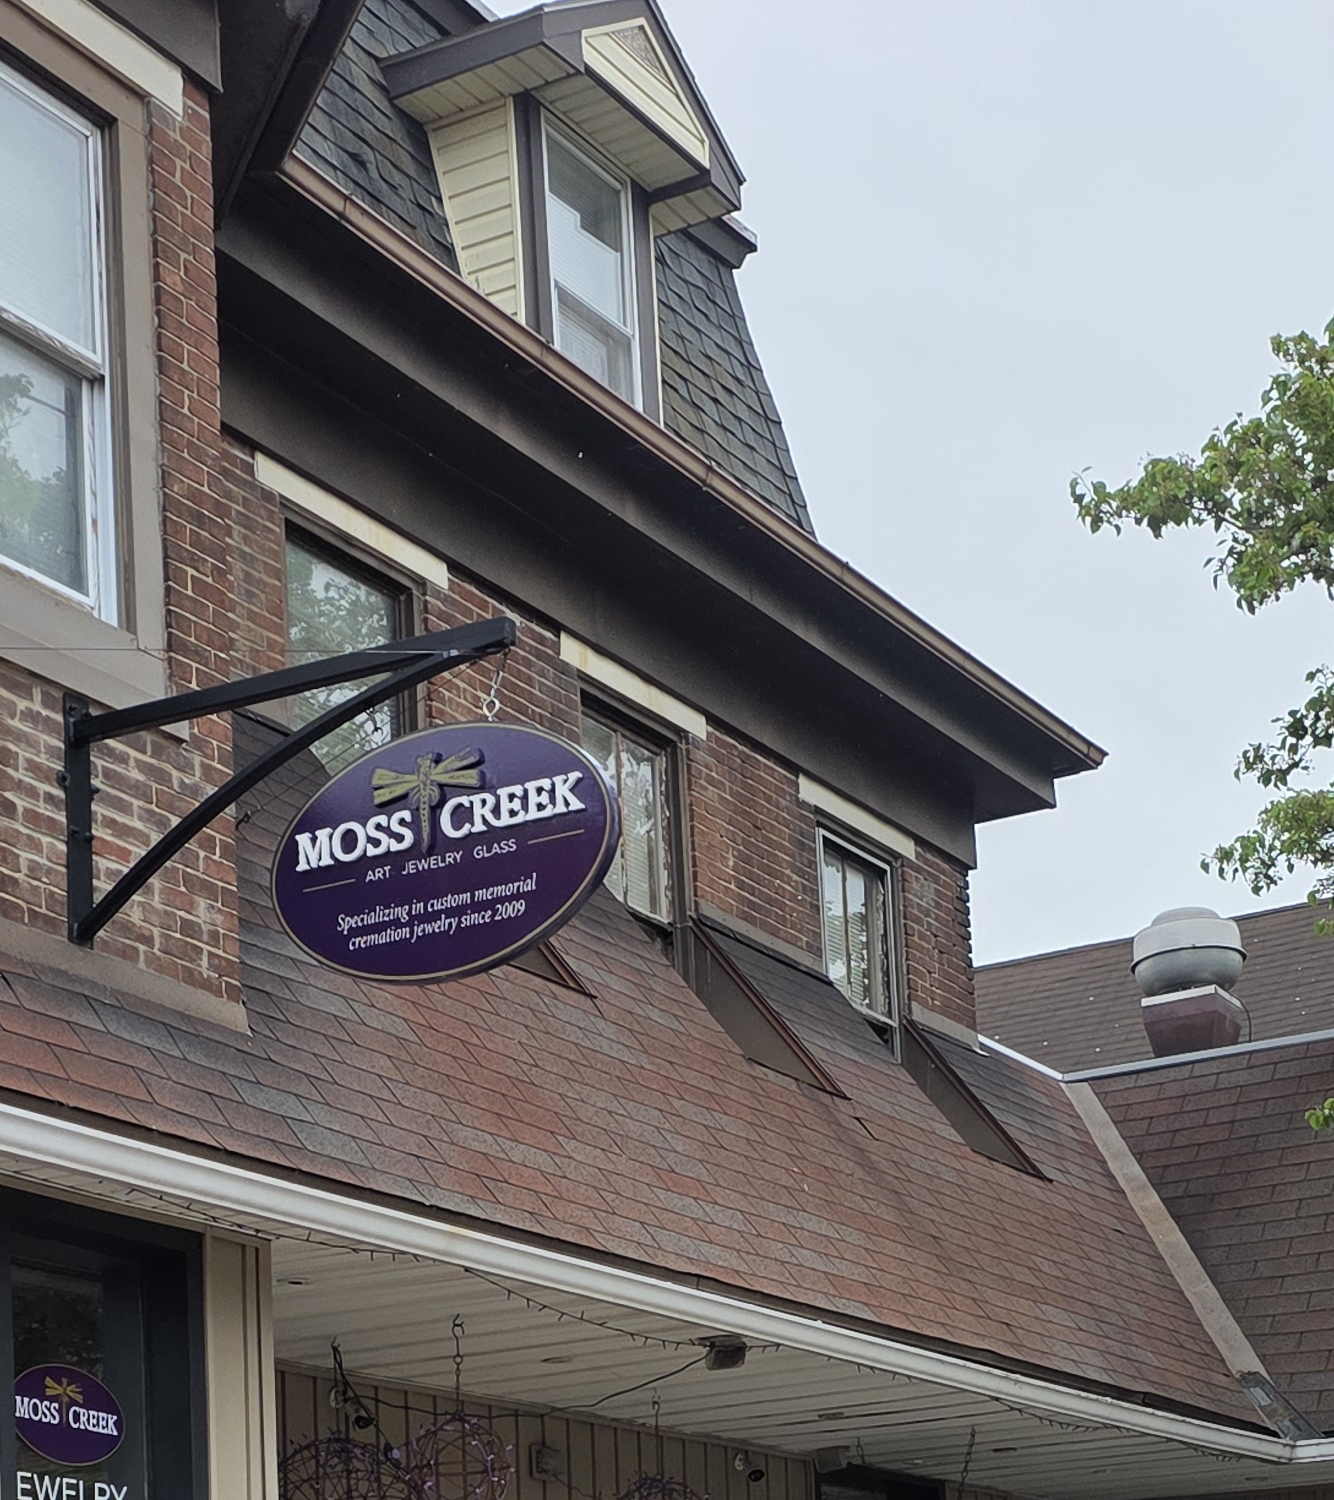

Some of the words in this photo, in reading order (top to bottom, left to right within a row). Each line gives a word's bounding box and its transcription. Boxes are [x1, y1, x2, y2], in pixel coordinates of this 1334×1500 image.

[295, 809, 414, 872] MOSS
[440, 771, 586, 839] CREEK
[365, 865, 392, 882] ART
[401, 851, 463, 876] JEWELRY
[473, 839, 517, 859] GLASS
[337, 904, 409, 934] Specializing
[411, 899, 424, 915] in
[427, 892, 471, 912] custom
[474, 872, 537, 902] memorial
[348, 926, 410, 950] cremation
[411, 914, 458, 943] jewelry
[460, 910, 492, 928] since
[494, 899, 526, 921] 2009
[15, 1396, 60, 1424] MOSS
[69, 1406, 118, 1435] CREEK
